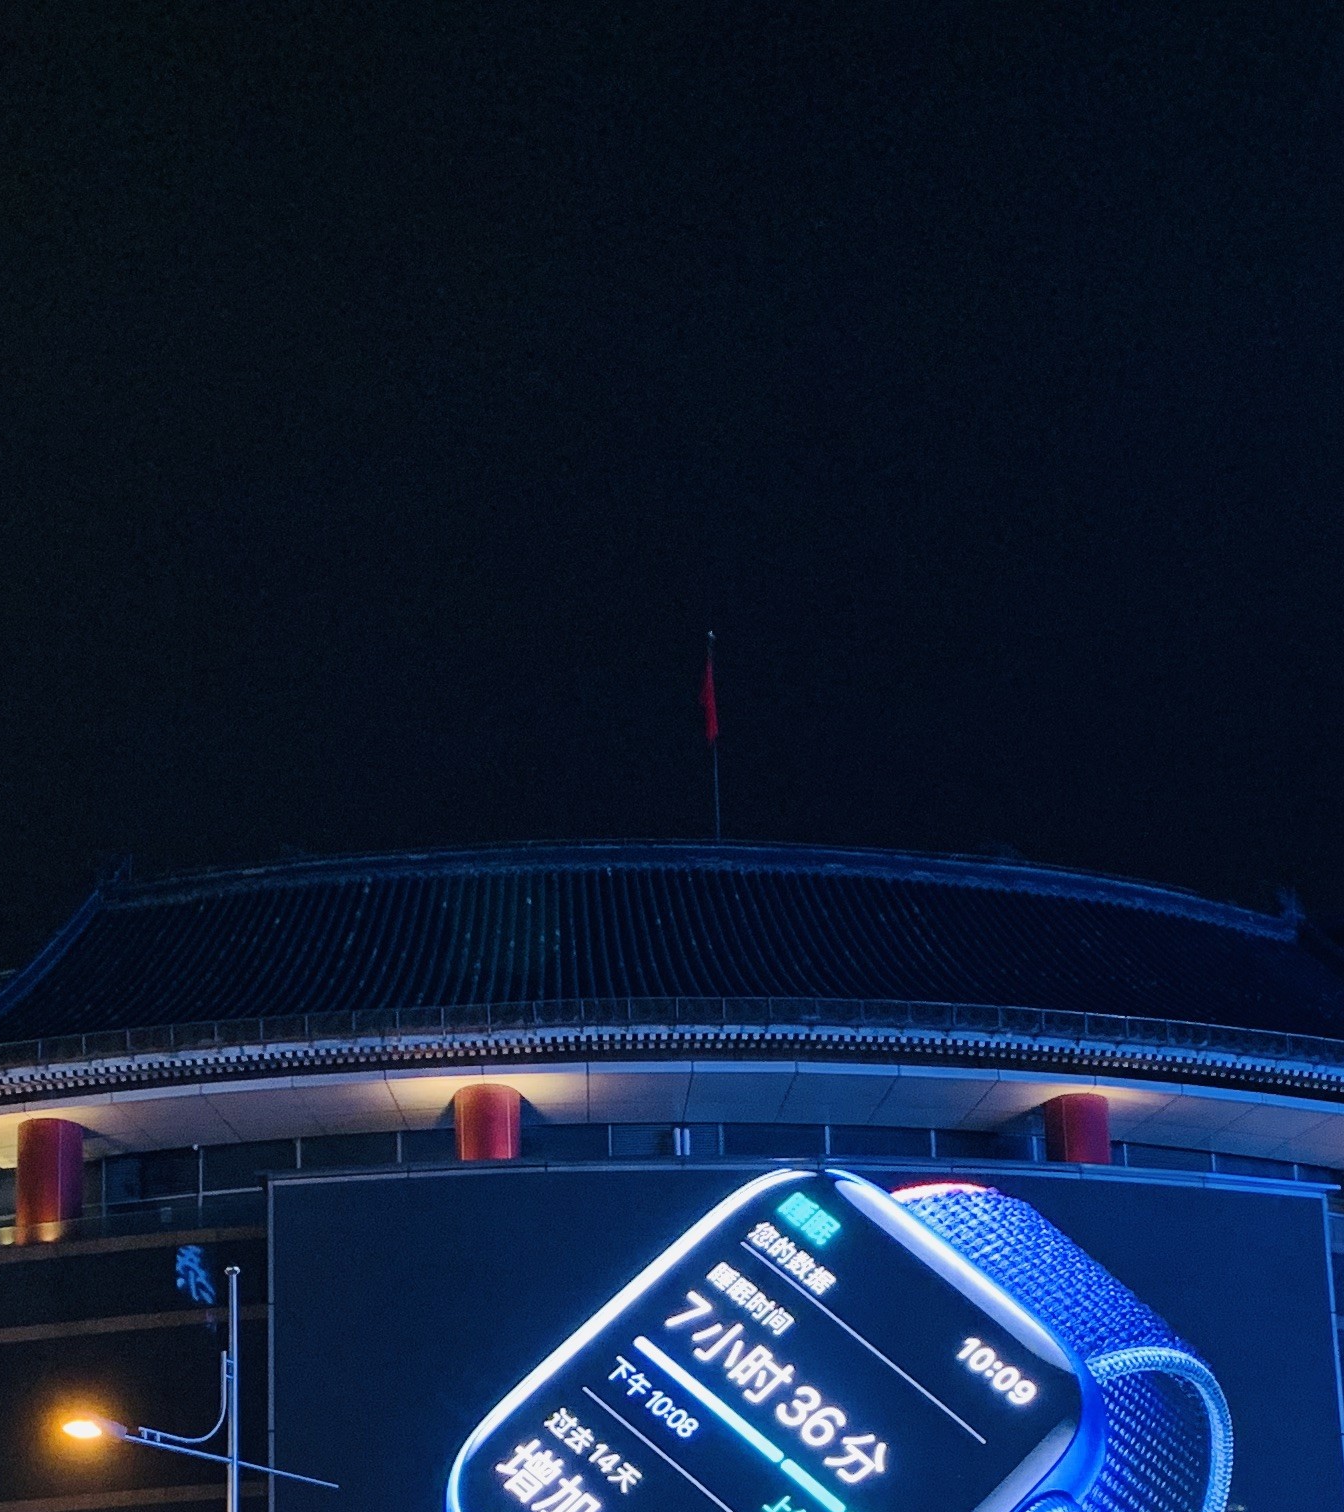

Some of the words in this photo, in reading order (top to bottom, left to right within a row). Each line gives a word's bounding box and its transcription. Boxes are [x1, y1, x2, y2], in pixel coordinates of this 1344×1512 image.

[776, 1191, 842, 1246] 睡眠
[747, 1221, 838, 1297] 您的数据
[705, 1260, 797, 1338] 睡眠时间
[957, 1335, 1039, 1407] 10:09
